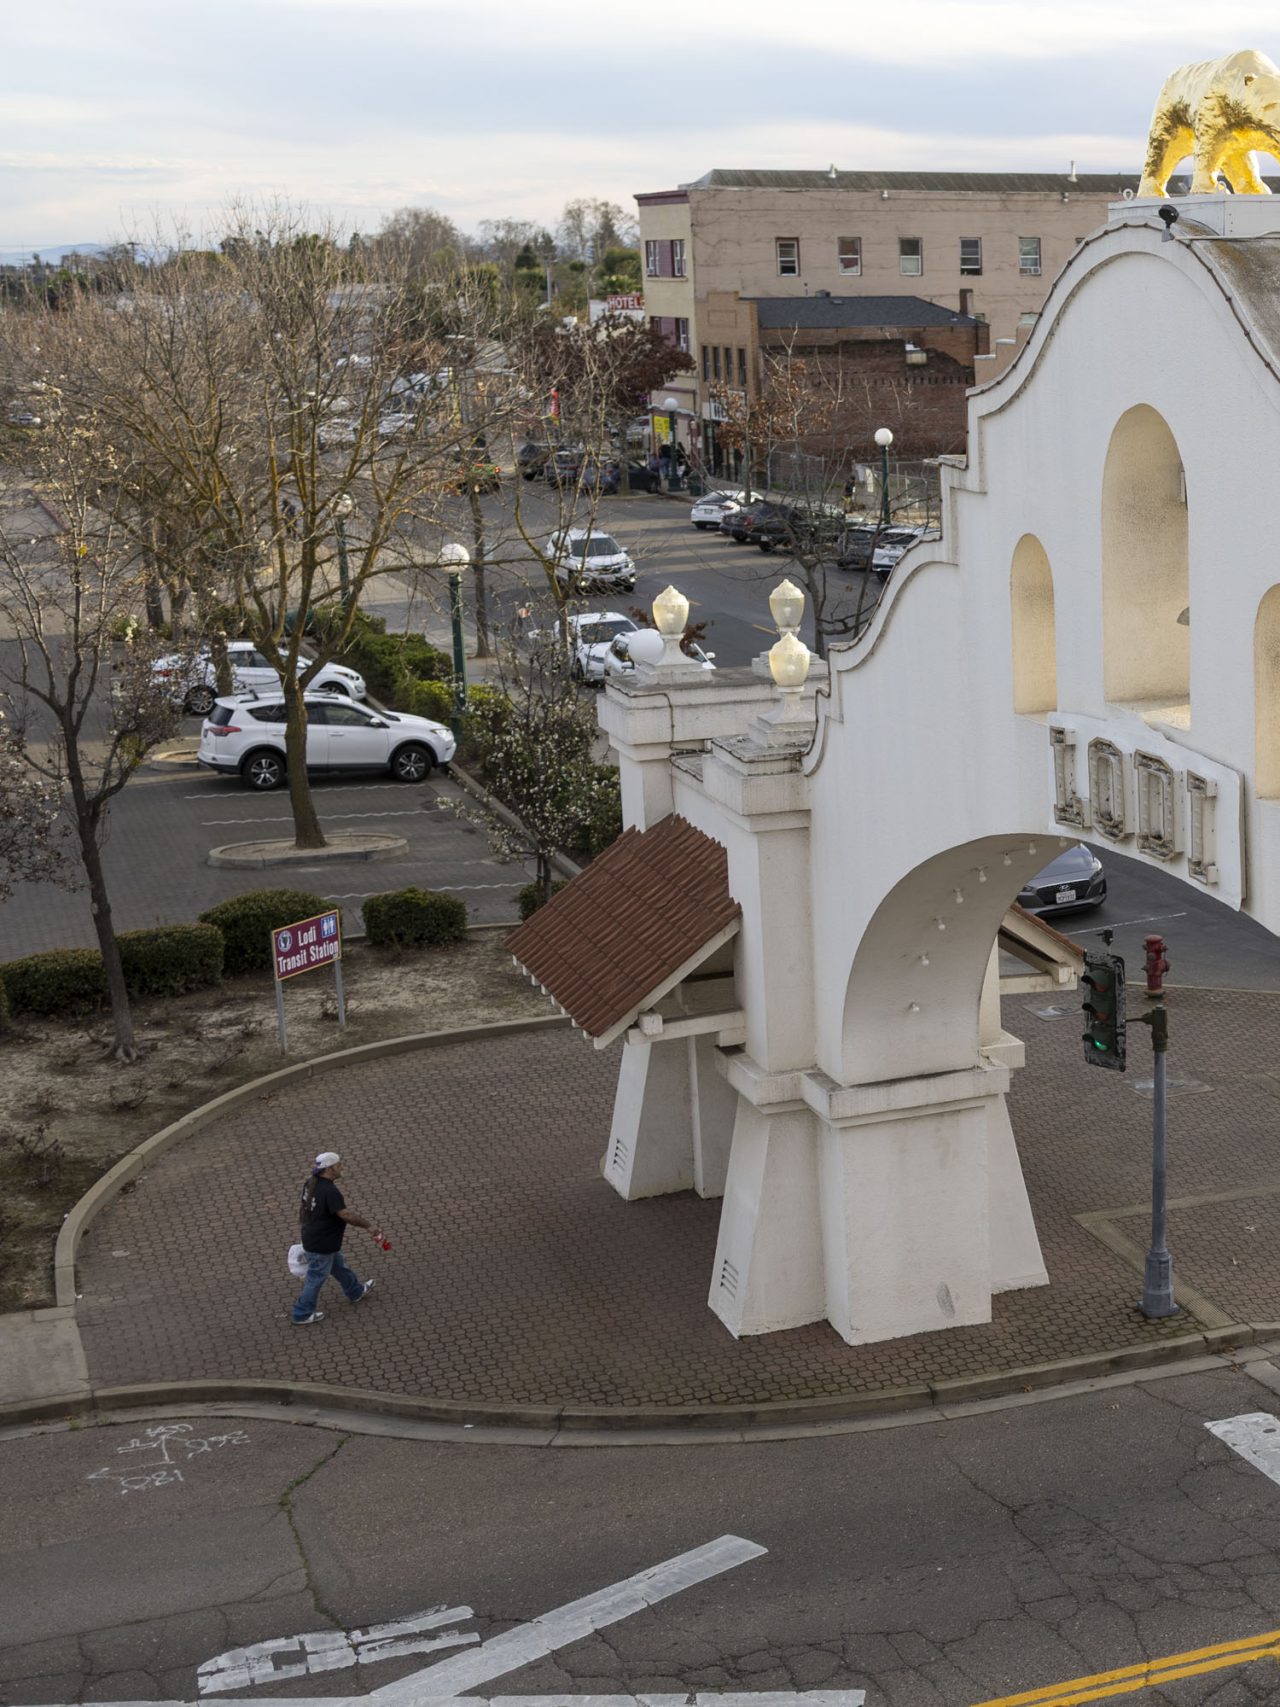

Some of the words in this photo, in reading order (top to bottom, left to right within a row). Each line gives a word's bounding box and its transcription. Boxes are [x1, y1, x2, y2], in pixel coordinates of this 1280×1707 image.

[608, 296, 640, 309] HOTEL
[1049, 725, 1219, 886] LODI
[297, 926, 317, 947] Lodi
[277, 950, 308, 973] Transit
[309, 940, 339, 962] Station
